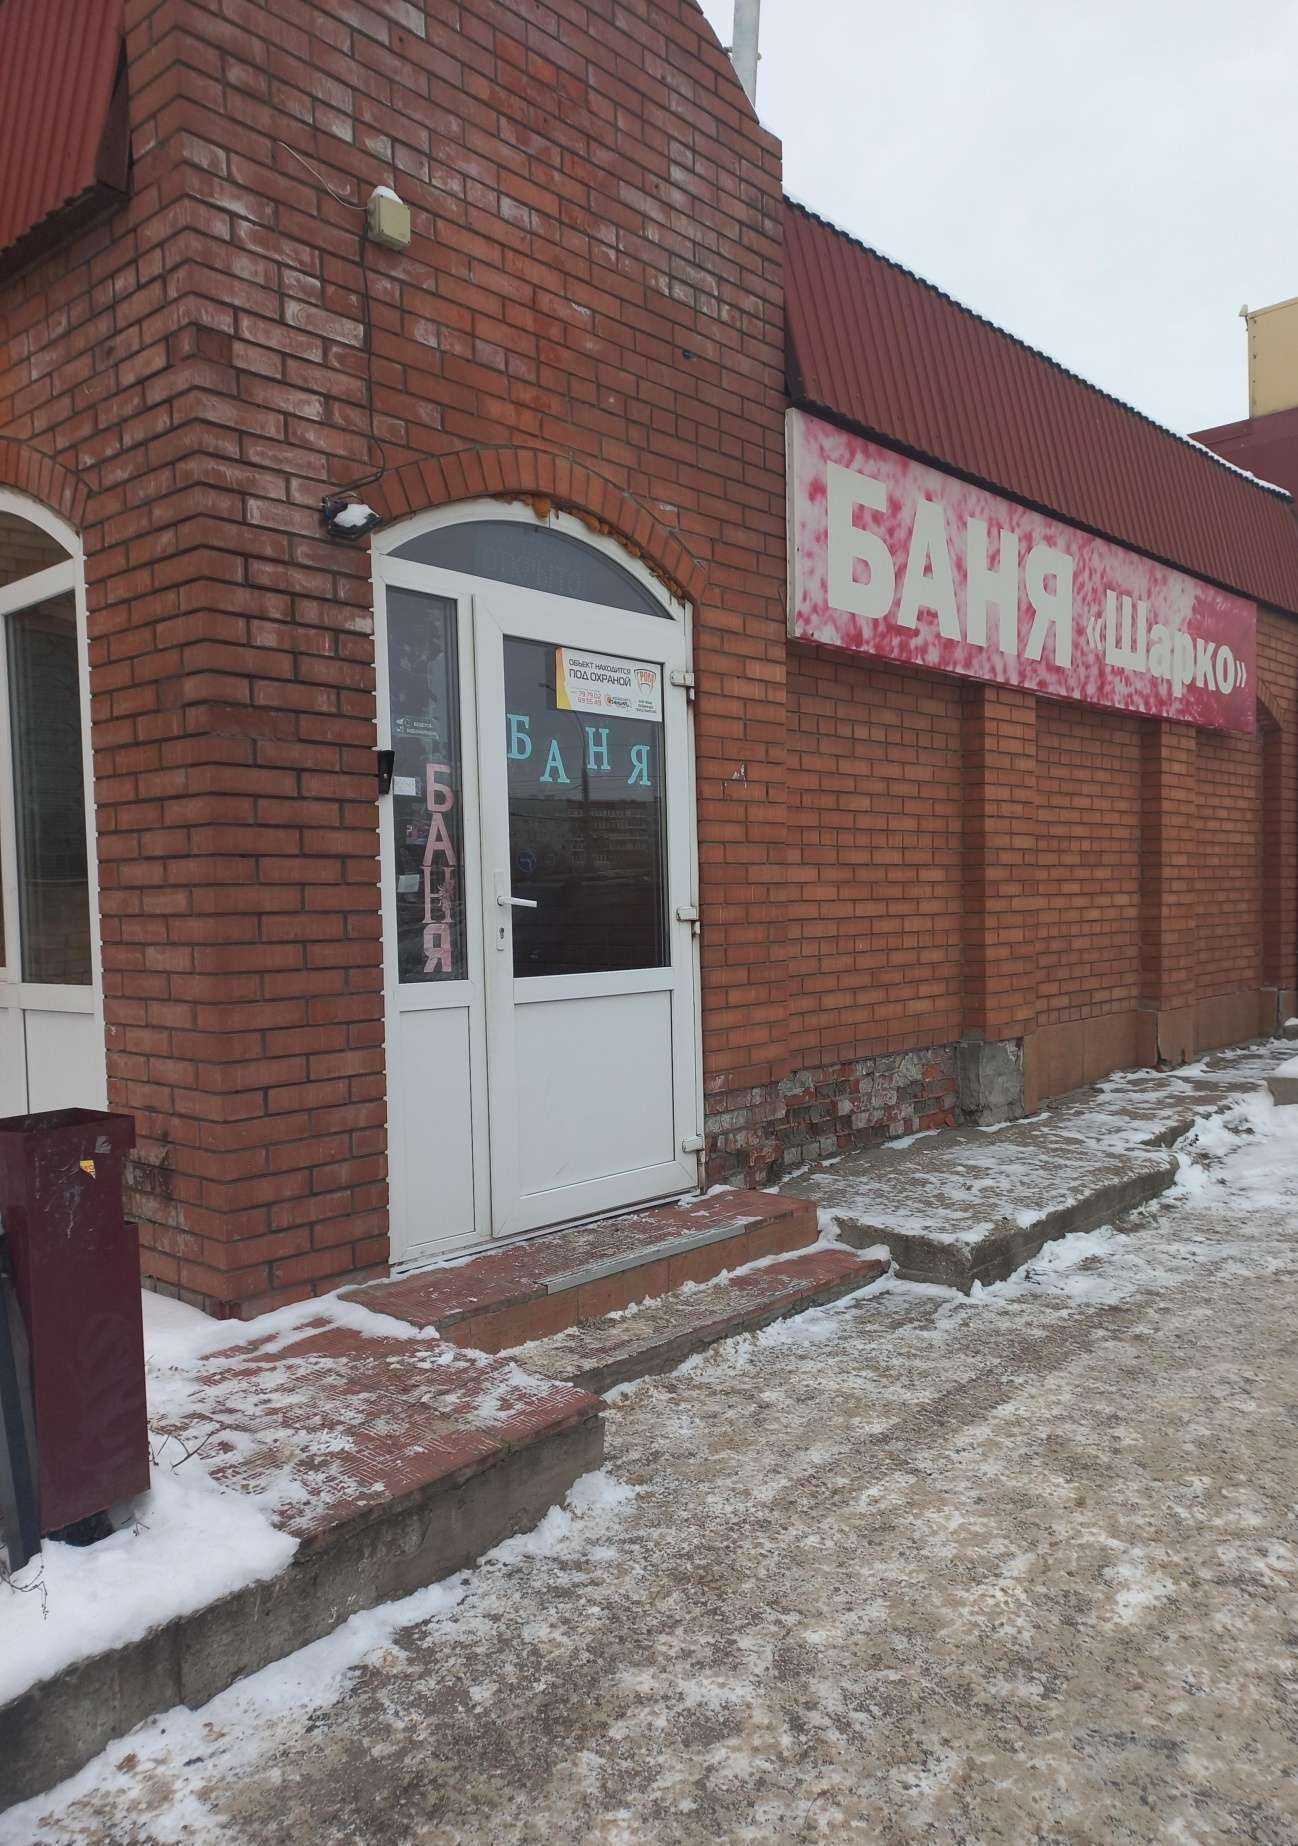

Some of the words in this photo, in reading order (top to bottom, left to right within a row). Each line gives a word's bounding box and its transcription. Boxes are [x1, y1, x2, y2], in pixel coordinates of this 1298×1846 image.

[827, 461, 1074, 669] БАНЯ
[1087, 589, 1247, 698] «Шарко»
[568, 659, 595, 669] ОБЪЕКТ
[595, 664, 631, 674] НАХОДИТСЯ
[569, 669, 589, 681] ПОД
[590, 672, 631, 687] ОХРАНОЙ
[506, 713, 652, 786] БАНЯ
[422, 763, 457, 973] БАНЯ
